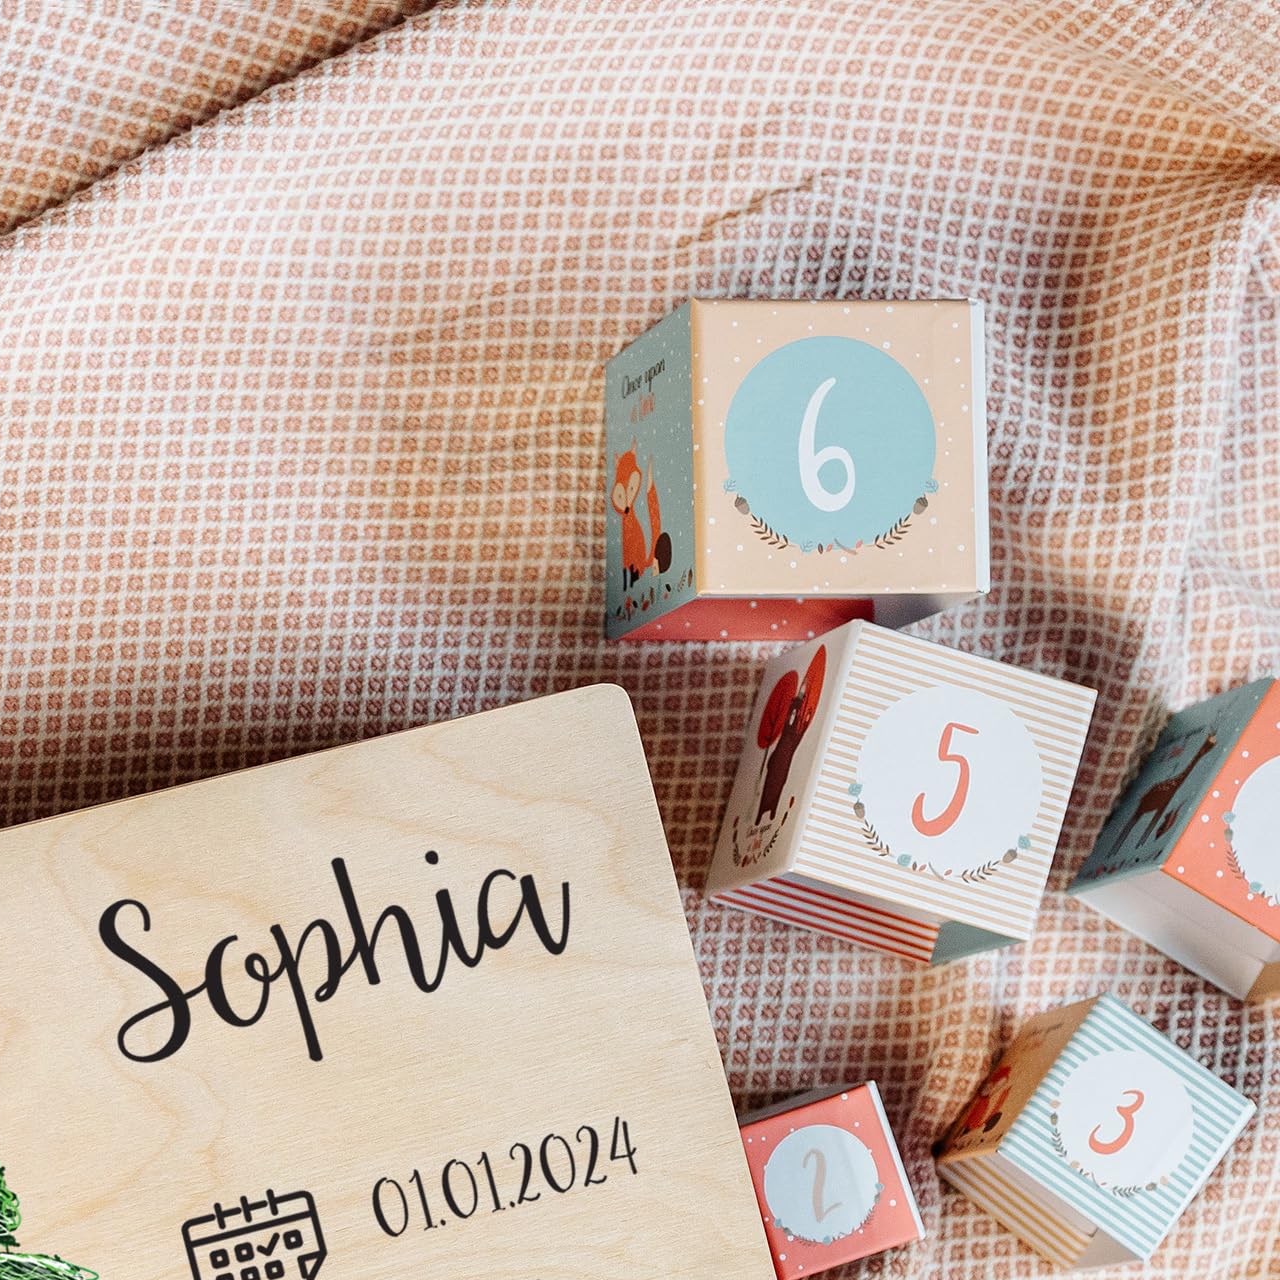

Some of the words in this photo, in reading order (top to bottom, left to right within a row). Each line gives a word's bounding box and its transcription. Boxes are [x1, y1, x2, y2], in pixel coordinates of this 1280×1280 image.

[644, 358, 666, 393] upon
[798, 376, 856, 512] 6
[911, 722, 979, 837] 5
[98, 850, 570, 1063] Sophia
[372, 1115, 639, 1239] 01.01.2024
[1088, 1089, 1145, 1155] 3
[802, 1147, 842, 1223] 2
